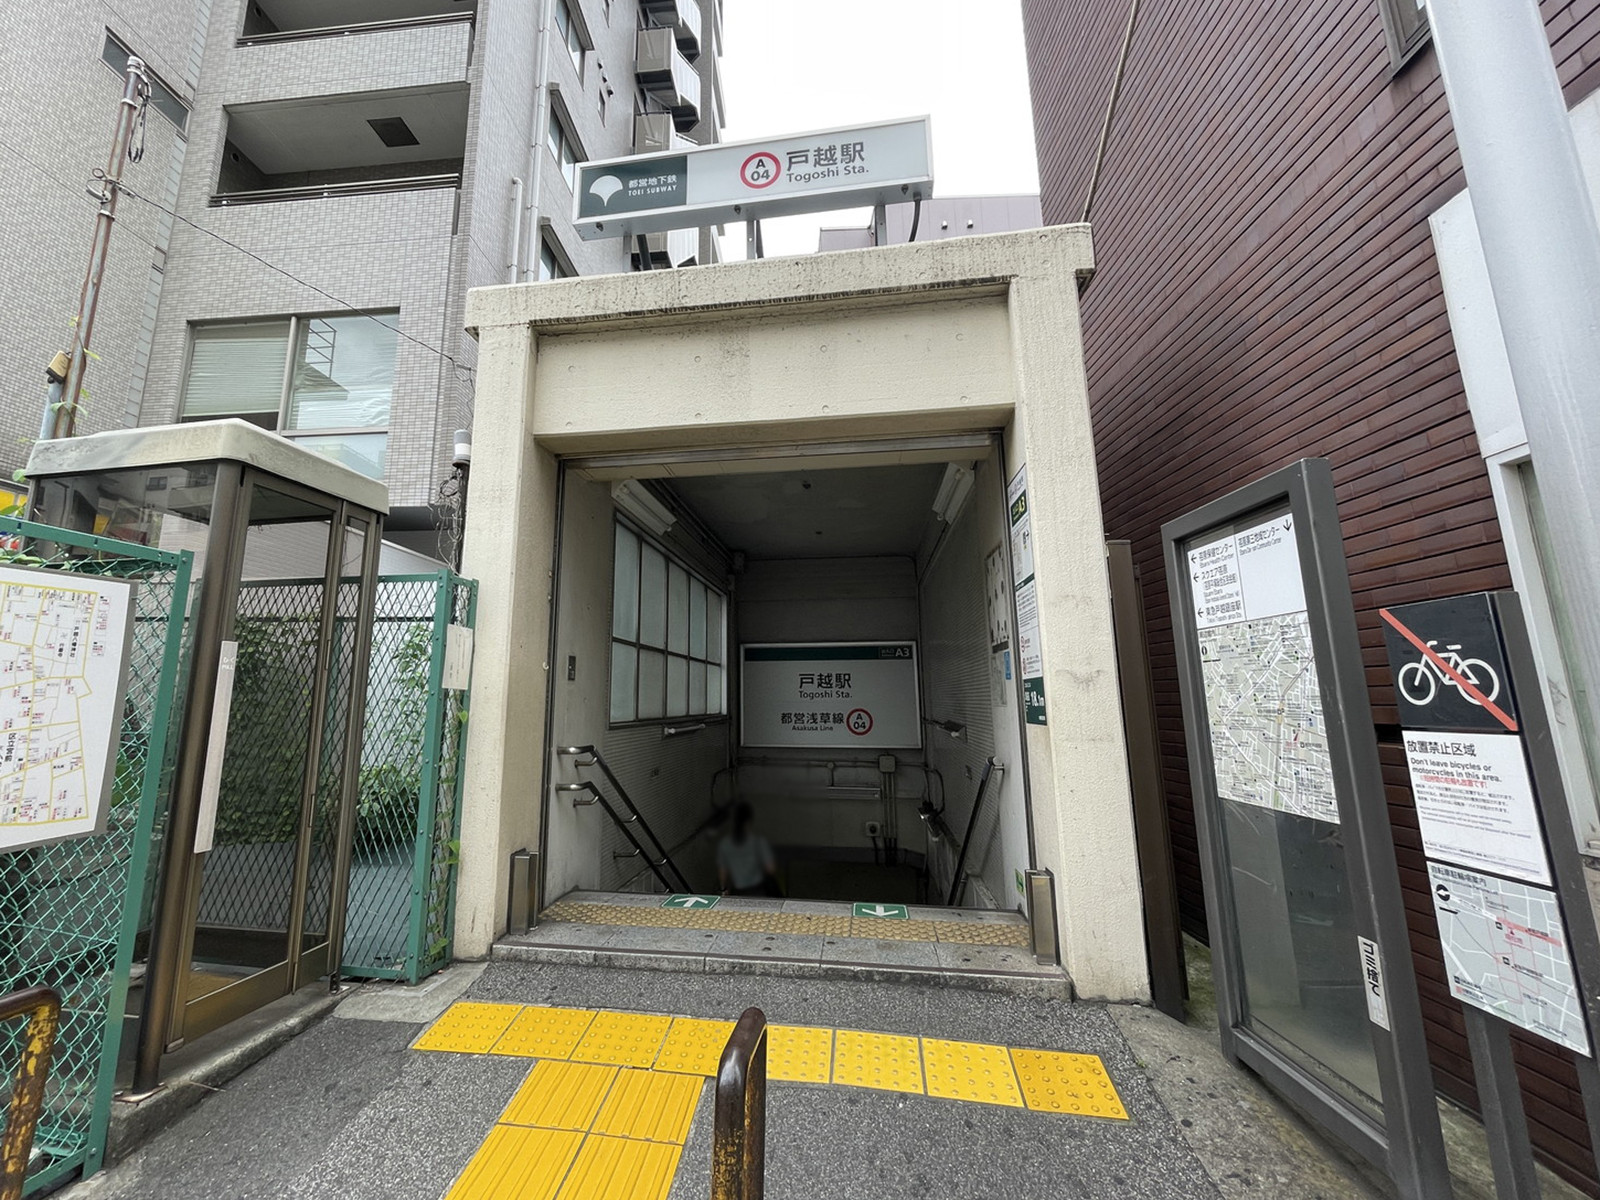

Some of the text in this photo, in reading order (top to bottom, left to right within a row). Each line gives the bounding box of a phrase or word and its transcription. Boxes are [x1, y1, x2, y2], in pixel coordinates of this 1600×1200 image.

[755, 158, 766, 169] A
[786, 142, 865, 172] 戸越駅
[750, 169, 770, 182] 04
[786, 164, 869, 183] Togoshi Sta.
[628, 174, 678, 189] 都営地下鉄
[895, 647, 910, 657] A3
[799, 673, 852, 689] 戸越駅
[799, 690, 853, 700] Togoshi Sta.
[781, 712, 844, 725] 都営浅草線
[856, 713, 863, 721] A
[853, 721, 866, 730] 04
[1407, 740, 1477, 757] 放置禁止区域
[1410, 757, 1428, 767] Don't
[1429, 758, 1448, 768] leave
[1450, 760, 1482, 771] bicycles
[1412, 766, 1454, 777] motorcycles
[1465, 771, 1480, 779] this
[1482, 775, 1503, 783] area.
